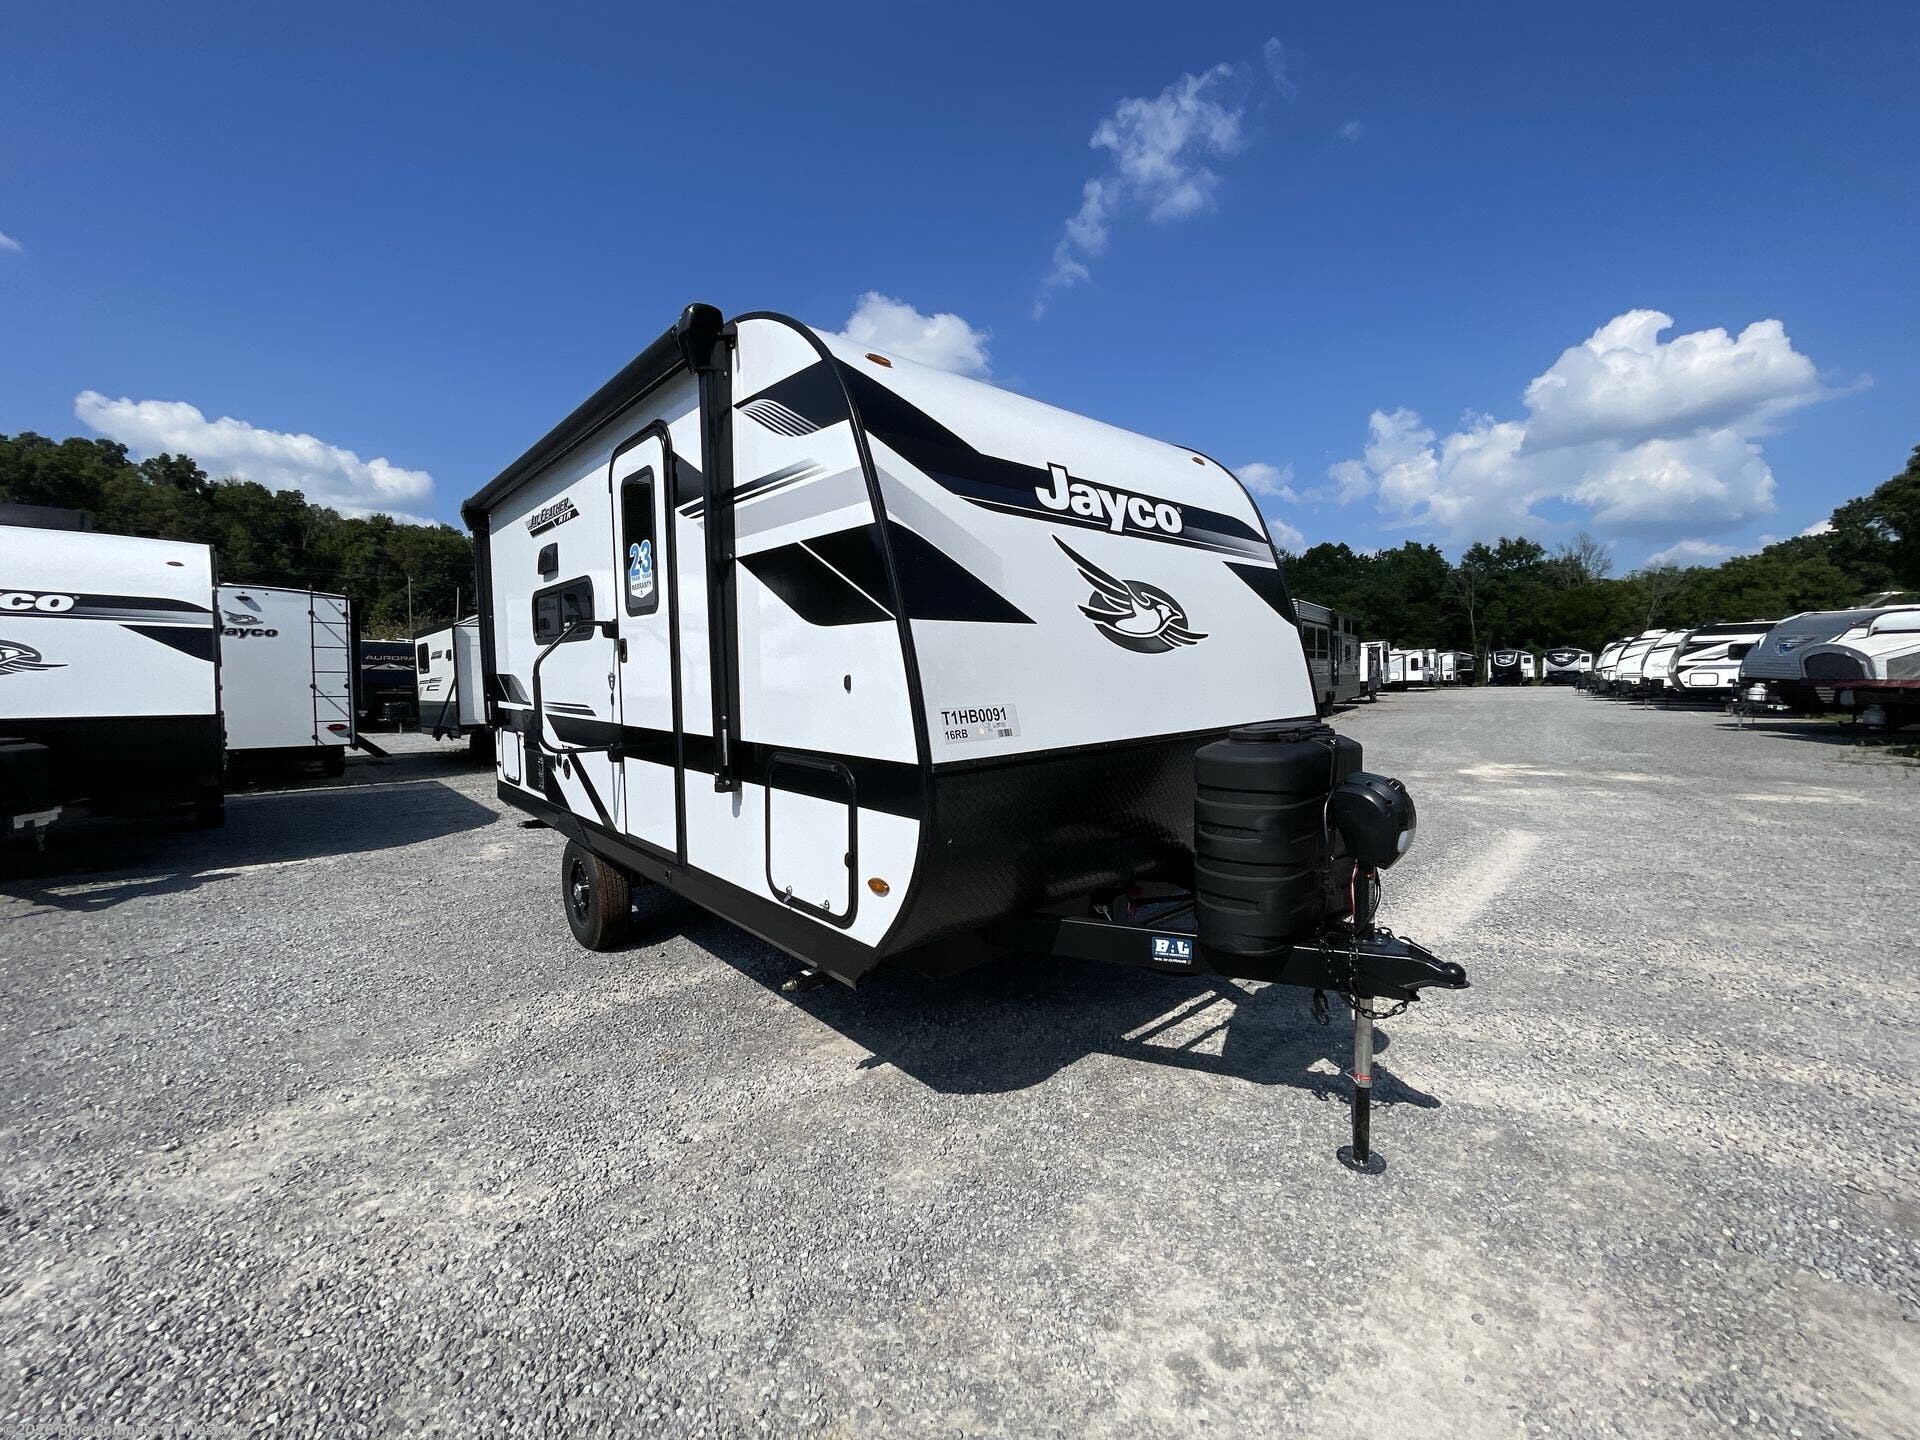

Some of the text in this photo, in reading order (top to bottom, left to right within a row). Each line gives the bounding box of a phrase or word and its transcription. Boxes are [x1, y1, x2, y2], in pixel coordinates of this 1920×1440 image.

[1035, 464, 1183, 533] Jayco
[221, 625, 279, 639] ayco
[941, 707, 1007, 725] T1HB0091
[945, 729, 969, 740] 16RB
